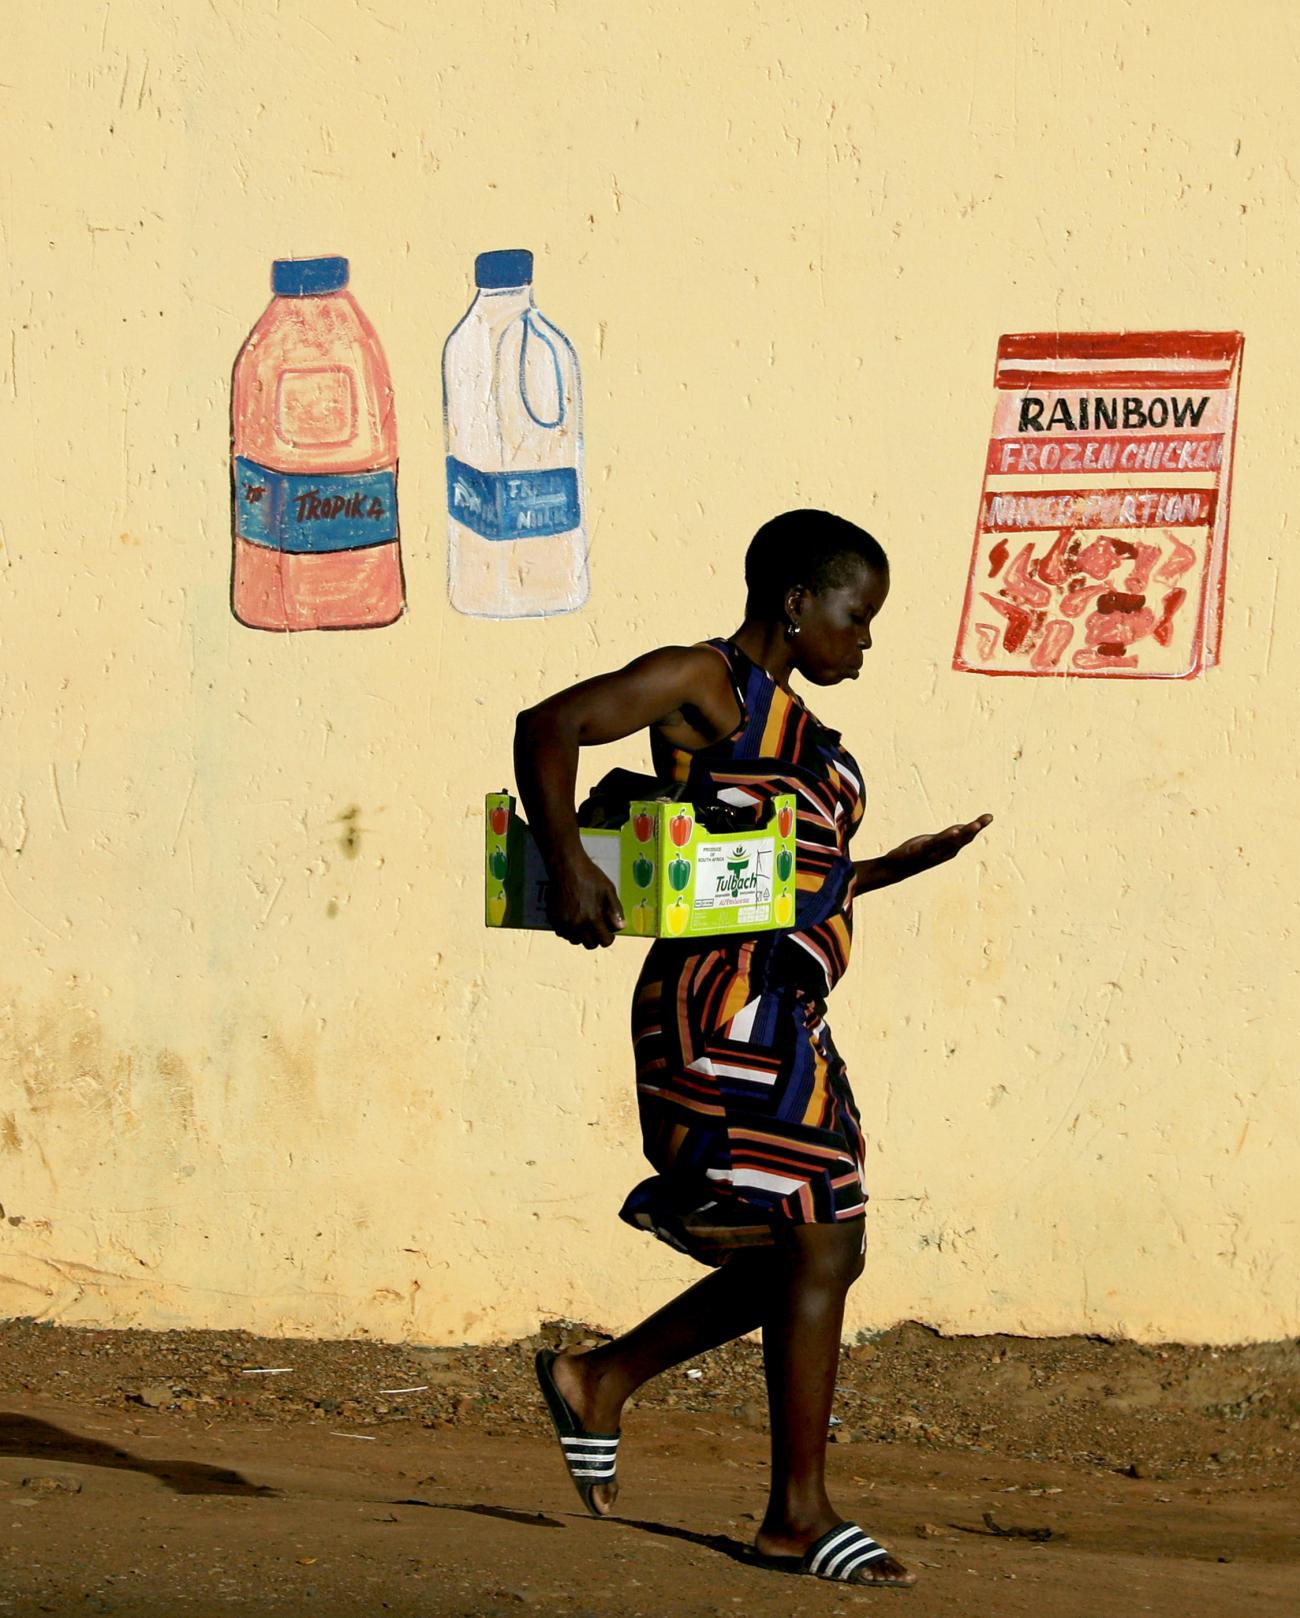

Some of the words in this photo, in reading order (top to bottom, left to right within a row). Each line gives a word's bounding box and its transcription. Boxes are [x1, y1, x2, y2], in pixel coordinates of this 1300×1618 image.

[1018, 395, 1212, 433] RAINBOW
[1000, 442, 1119, 472] FROZEN
[1120, 440, 1224, 470] CHICKEN
[293, 490, 386, 523] TROPIKA
[716, 872, 757, 892] Tulbach
